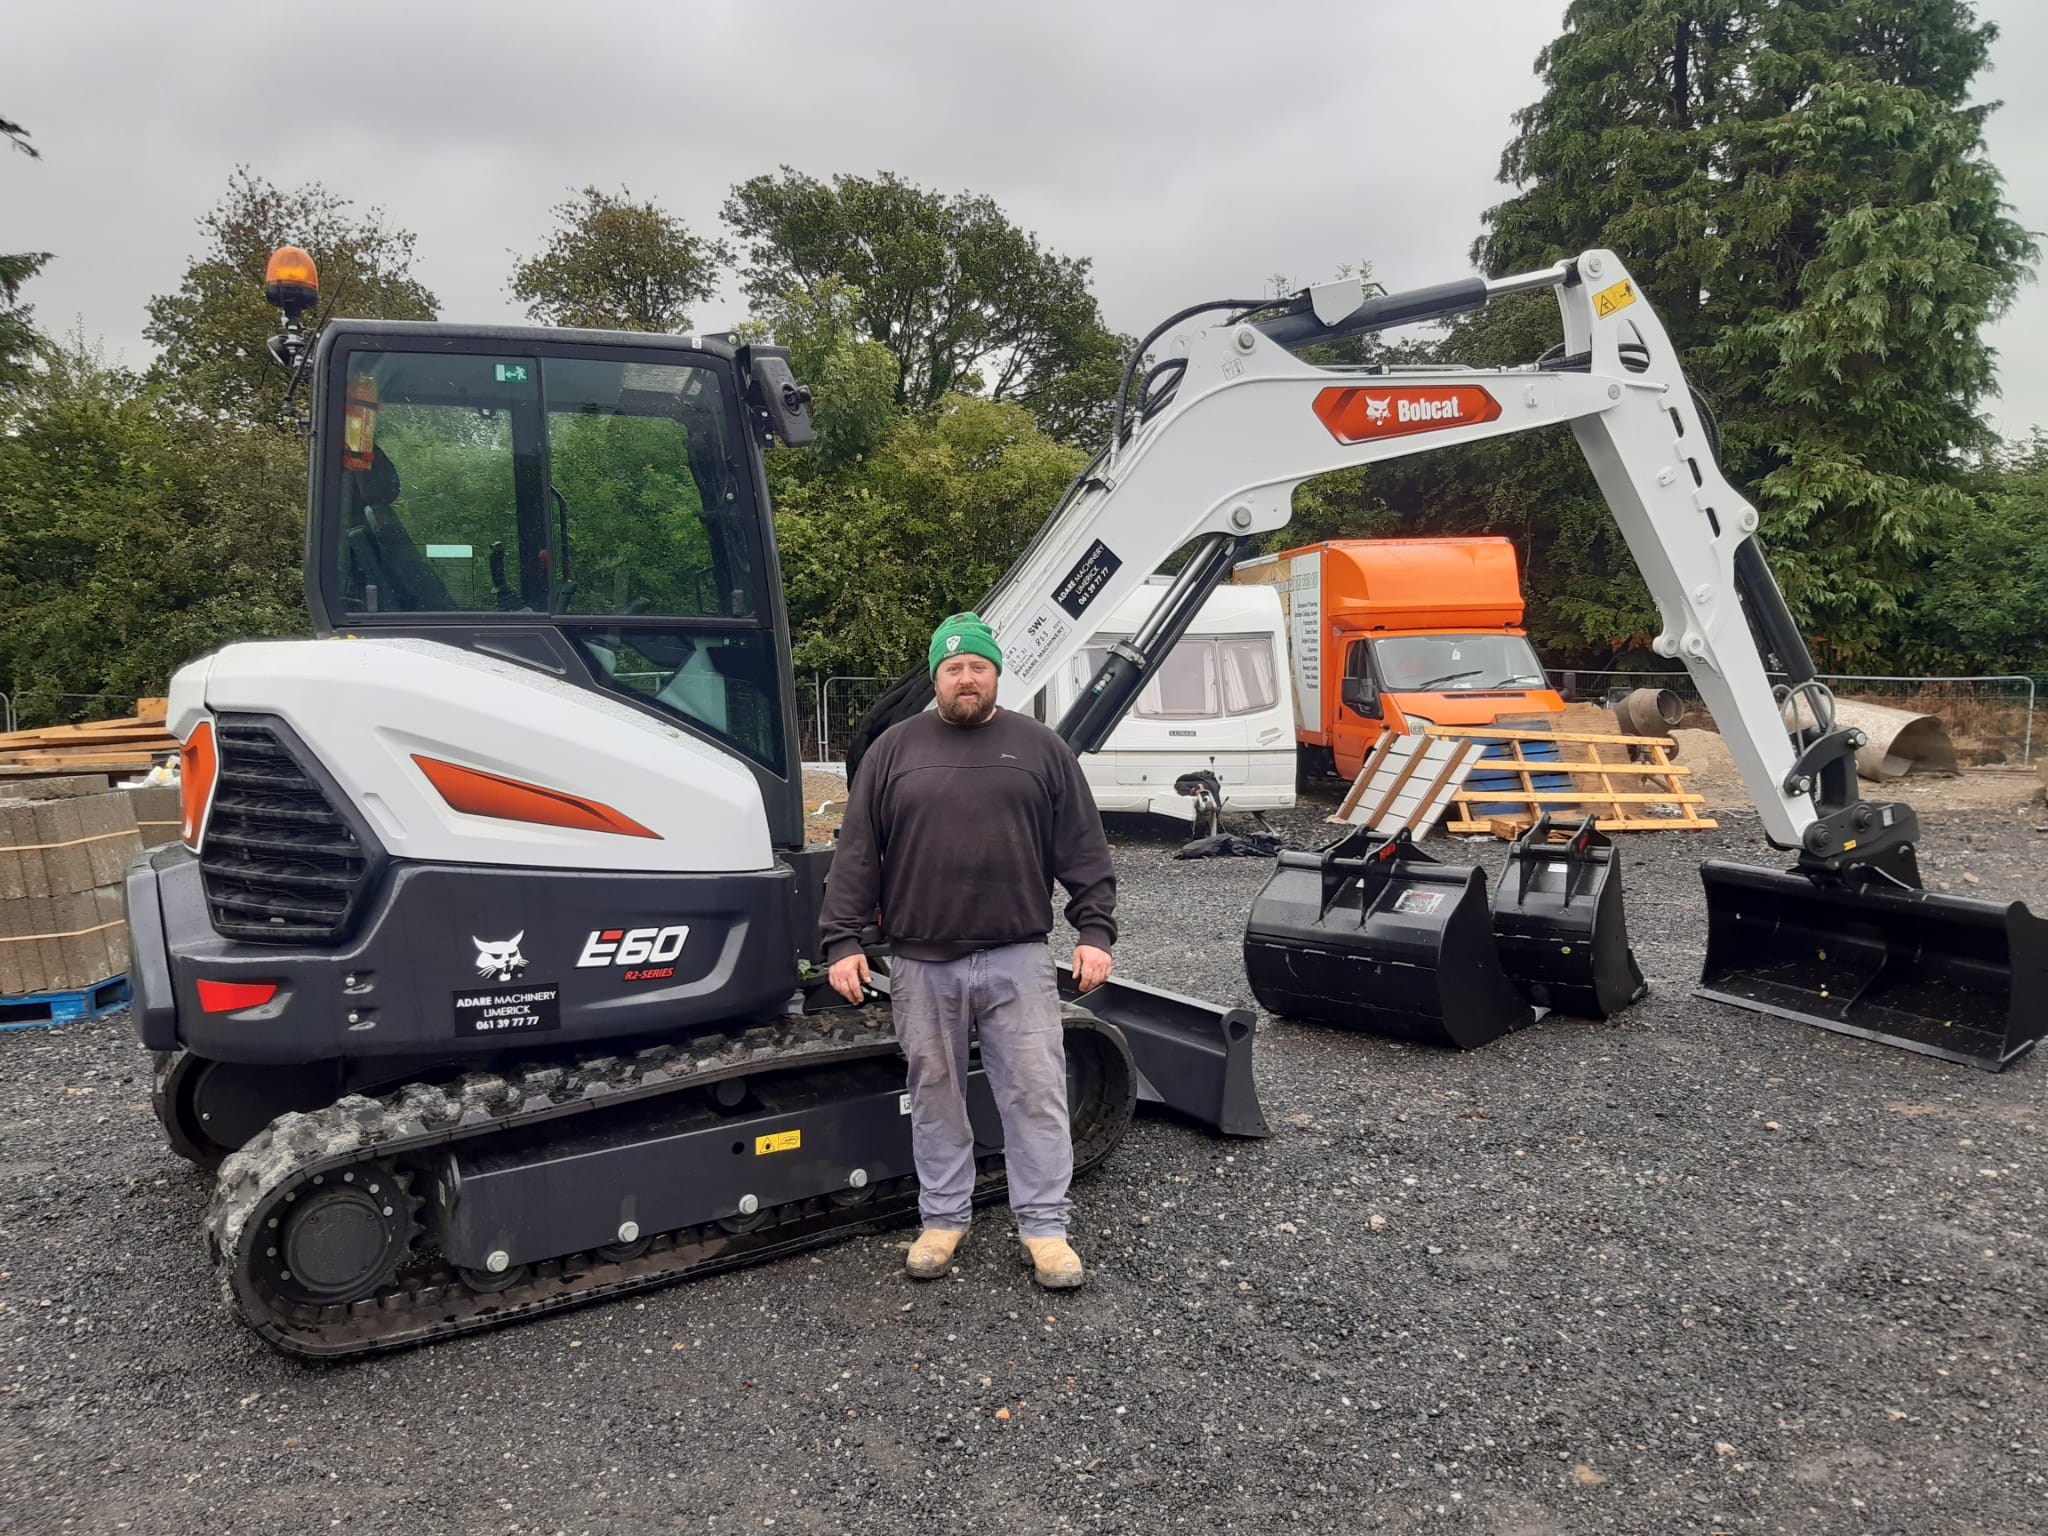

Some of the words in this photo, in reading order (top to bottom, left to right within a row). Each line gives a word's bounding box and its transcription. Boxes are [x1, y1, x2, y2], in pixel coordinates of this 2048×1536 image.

[1397, 396, 1460, 422] Bobcat
[1058, 580, 1076, 603] ADARE
[1074, 544, 1105, 582] MACHINERY
[1075, 565, 1099, 594] LIMERICK
[1078, 592, 1090, 605] 061
[1087, 583, 1096, 594] 39
[1094, 575, 1102, 585] 77
[1101, 566, 1109, 577] 77
[1027, 616, 1047, 636] SWL
[1022, 659, 1038, 678] ADARE
[1037, 626, 1064, 658] MACHINERY
[576, 925, 690, 967] E60
[624, 967, 674, 980] R2-SERIES
[456, 996, 492, 1008] ADARE
[494, 990, 557, 1005] MACHINERY
[483, 1005, 530, 1017] LIMERICK
[476, 1020, 494, 1030] 061
[497, 1018, 510, 1028] 39
[511, 1017, 525, 1027] 77
[526, 1016, 539, 1025] 77
